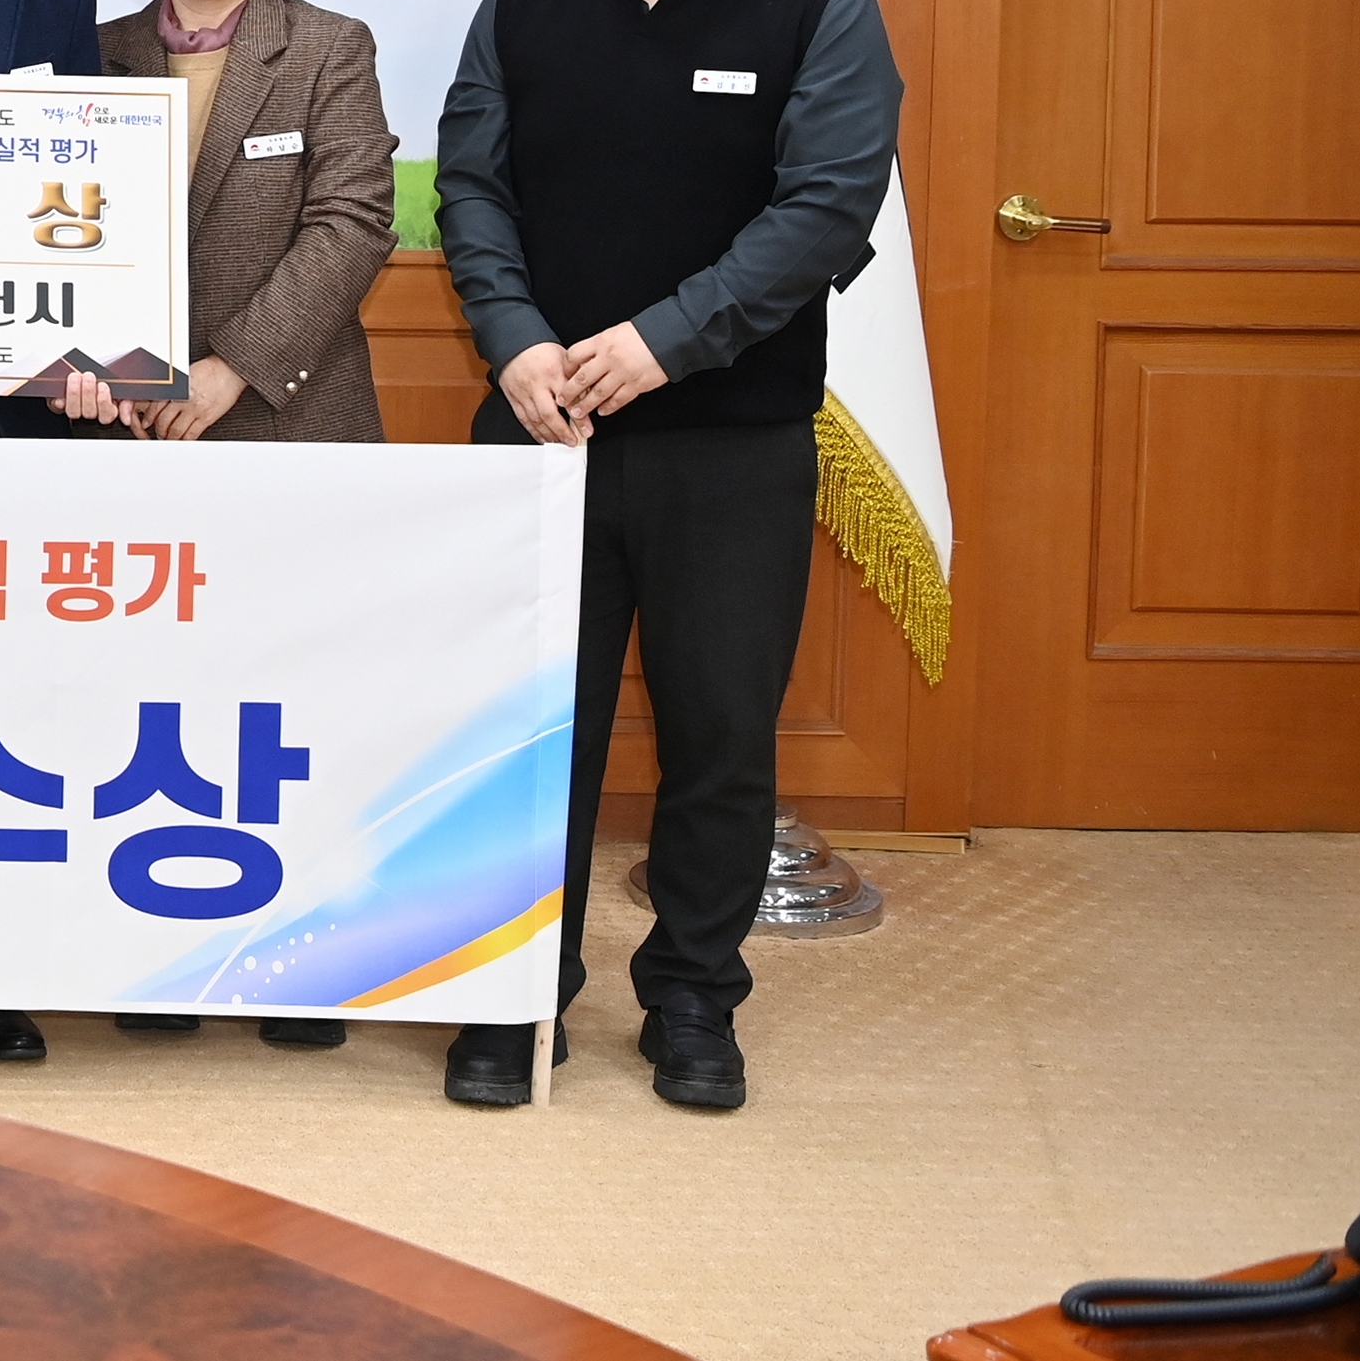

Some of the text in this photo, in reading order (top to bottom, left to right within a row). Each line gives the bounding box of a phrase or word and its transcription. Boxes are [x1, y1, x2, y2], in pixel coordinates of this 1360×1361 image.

[120, 115, 163, 126] 대한민국
[49, 138, 99, 165] 평가
[42, 541, 208, 624] 평가
